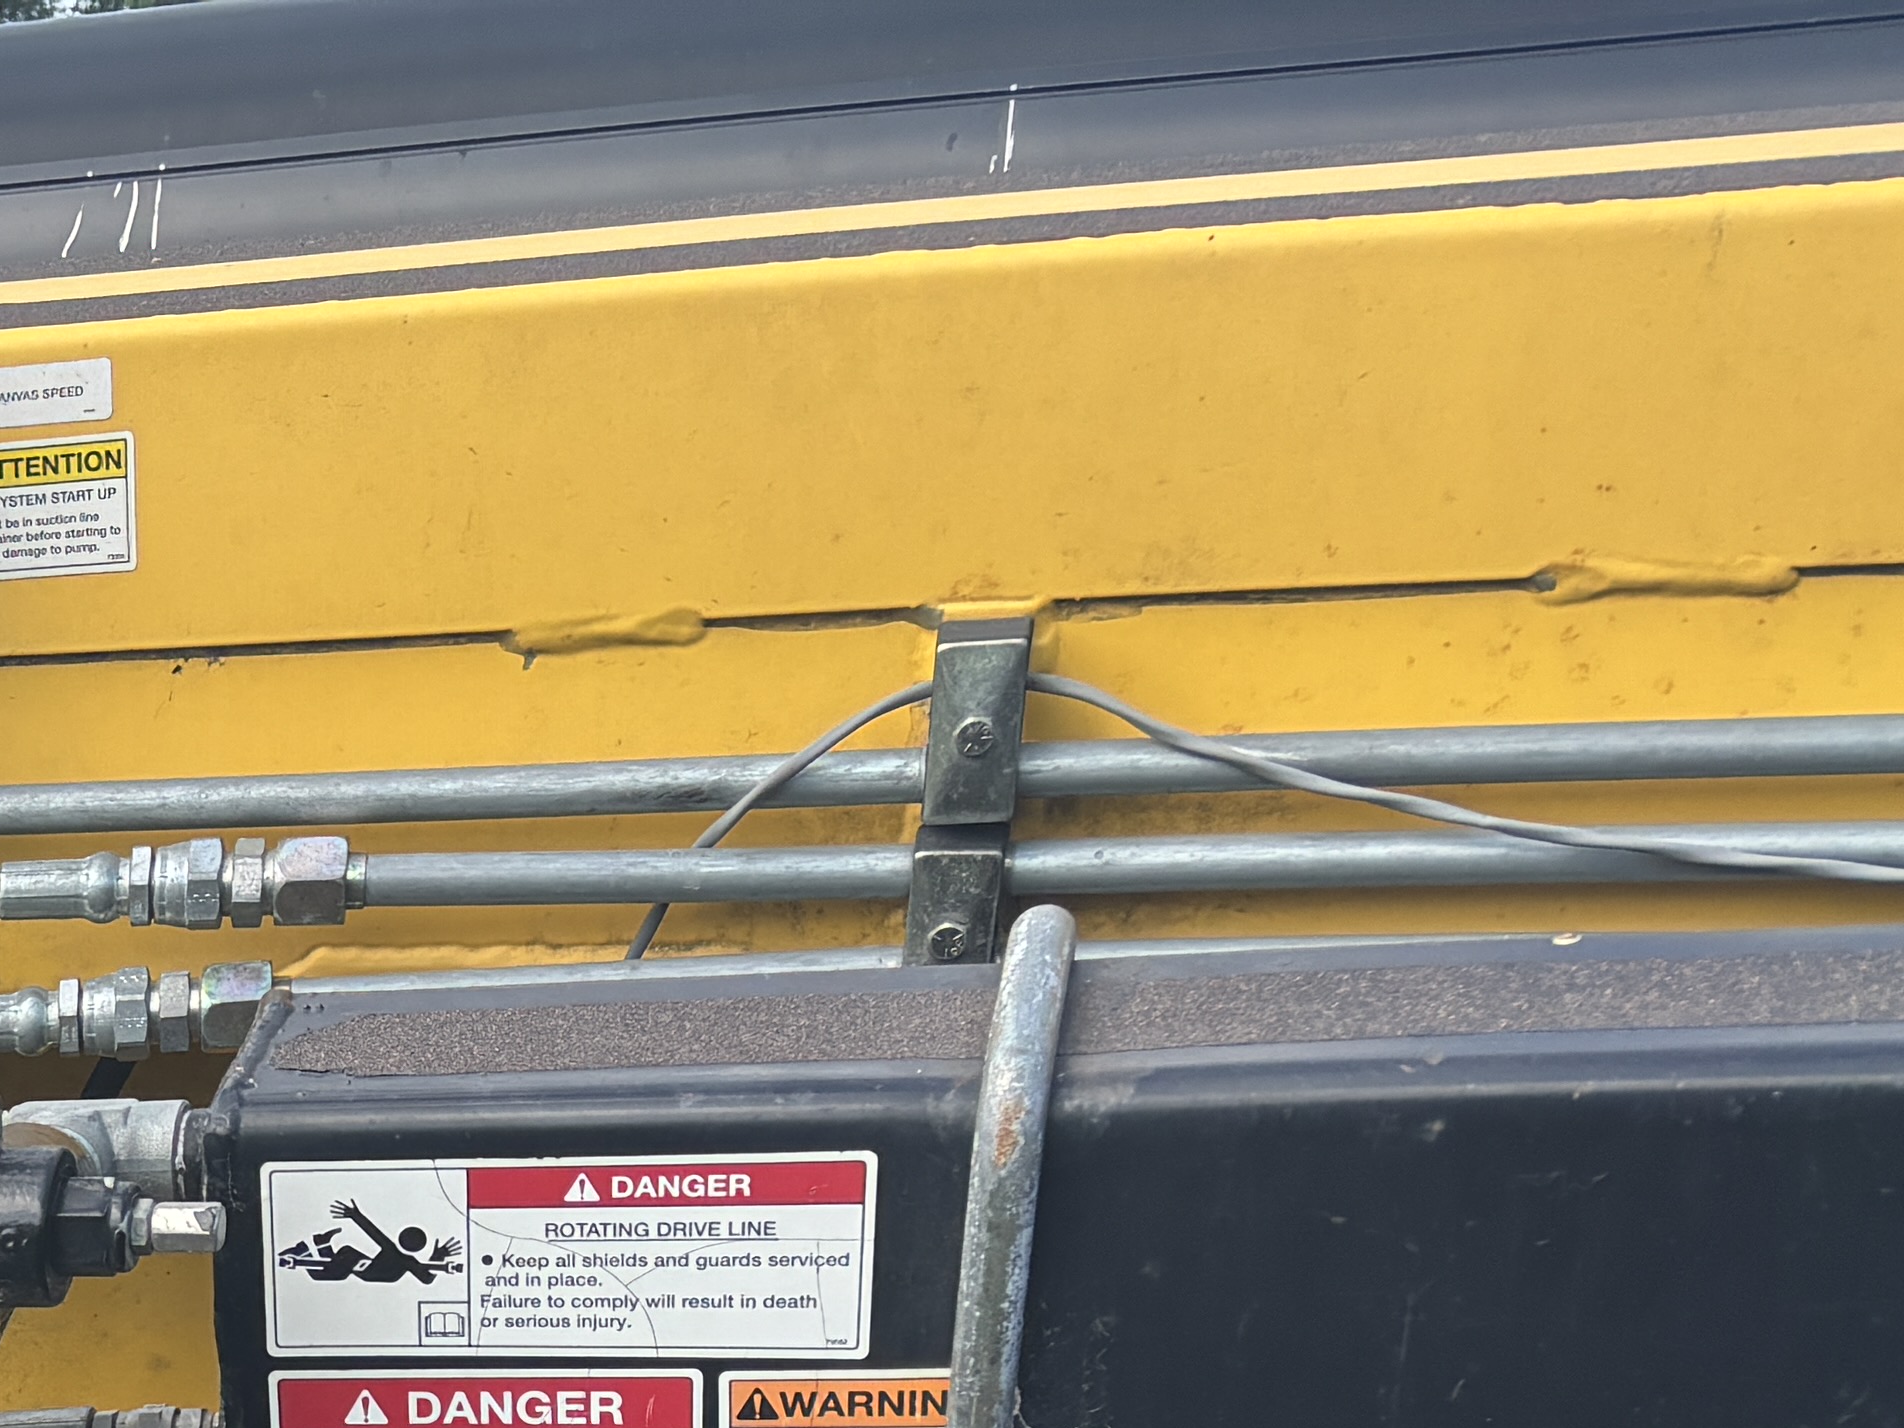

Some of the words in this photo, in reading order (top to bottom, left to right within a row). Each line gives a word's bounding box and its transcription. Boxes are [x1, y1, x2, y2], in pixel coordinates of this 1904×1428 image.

[42, 385, 84, 399] SPEED
[52, 489, 93, 504] START
[97, 487, 116, 500] UP
[5, 518, 19, 529] be
[22, 516, 33, 527] in
[36, 514, 76, 526] suction
[26, 530, 61, 542] before
[65, 527, 107, 541] starting
[110, 525, 121, 536] to
[2, 547, 46, 560] damage
[50, 545, 62, 555] to
[65, 543, 100, 556] pump.
[611, 1174, 751, 1198] DANGER
[545, 1222, 649, 1238] ROTATING
[657, 1221, 721, 1237] DRIVE
[728, 1221, 777, 1237] LINE
[502, 1254, 550, 1271] Keep
[555, 1254, 575, 1268] all
[582, 1253, 648, 1268] shields
[654, 1253, 689, 1268] and
[695, 1253, 762, 1271] guards
[768, 1252, 850, 1267] serviced
[485, 1273, 519, 1287] and
[525, 1273, 541, 1287] in
[547, 1273, 603, 1292] place.
[480, 1295, 541, 1309] Failure
[547, 1296, 565, 1309] to
[571, 1295, 639, 1312] comply
[646, 1295, 675, 1308] will
[681, 1295, 734, 1309] result
[740, 1295, 756, 1308] in
[763, 1295, 817, 1308] death
[480, 1317, 498, 1328] or
[504, 1315, 571, 1328] serious
[576, 1315, 632, 1331] injury.
[407, 1391, 623, 1425] DANGER
[780, 1389, 948, 1418] WARNIN
